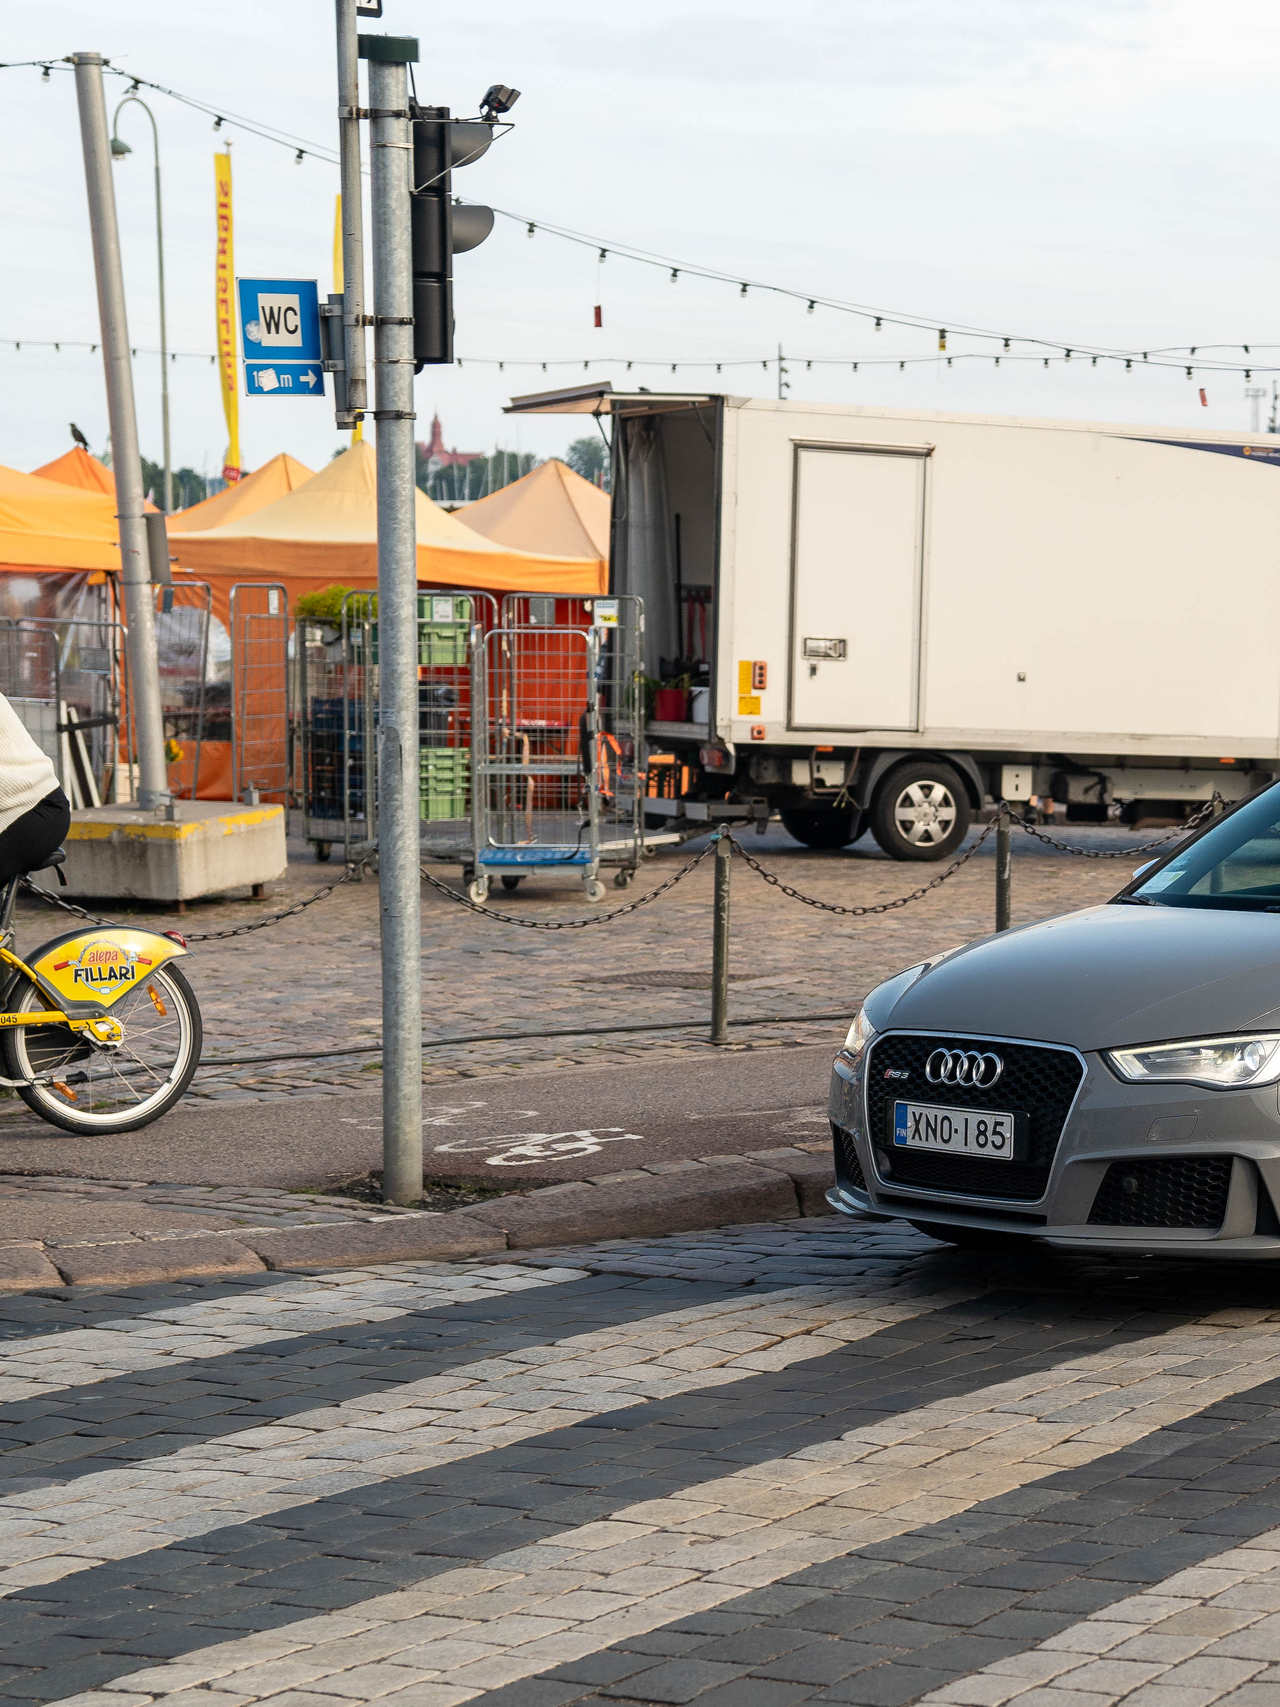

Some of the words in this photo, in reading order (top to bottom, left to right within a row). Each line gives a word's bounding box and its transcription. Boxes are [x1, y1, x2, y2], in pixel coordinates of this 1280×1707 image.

[261, 306, 299, 335] WC
[88, 950, 118, 963] alepa
[74, 965, 136, 983] FILLARI
[896, 1128, 907, 1137] FIN
[911, 1111, 1006, 1150] XNO-185
